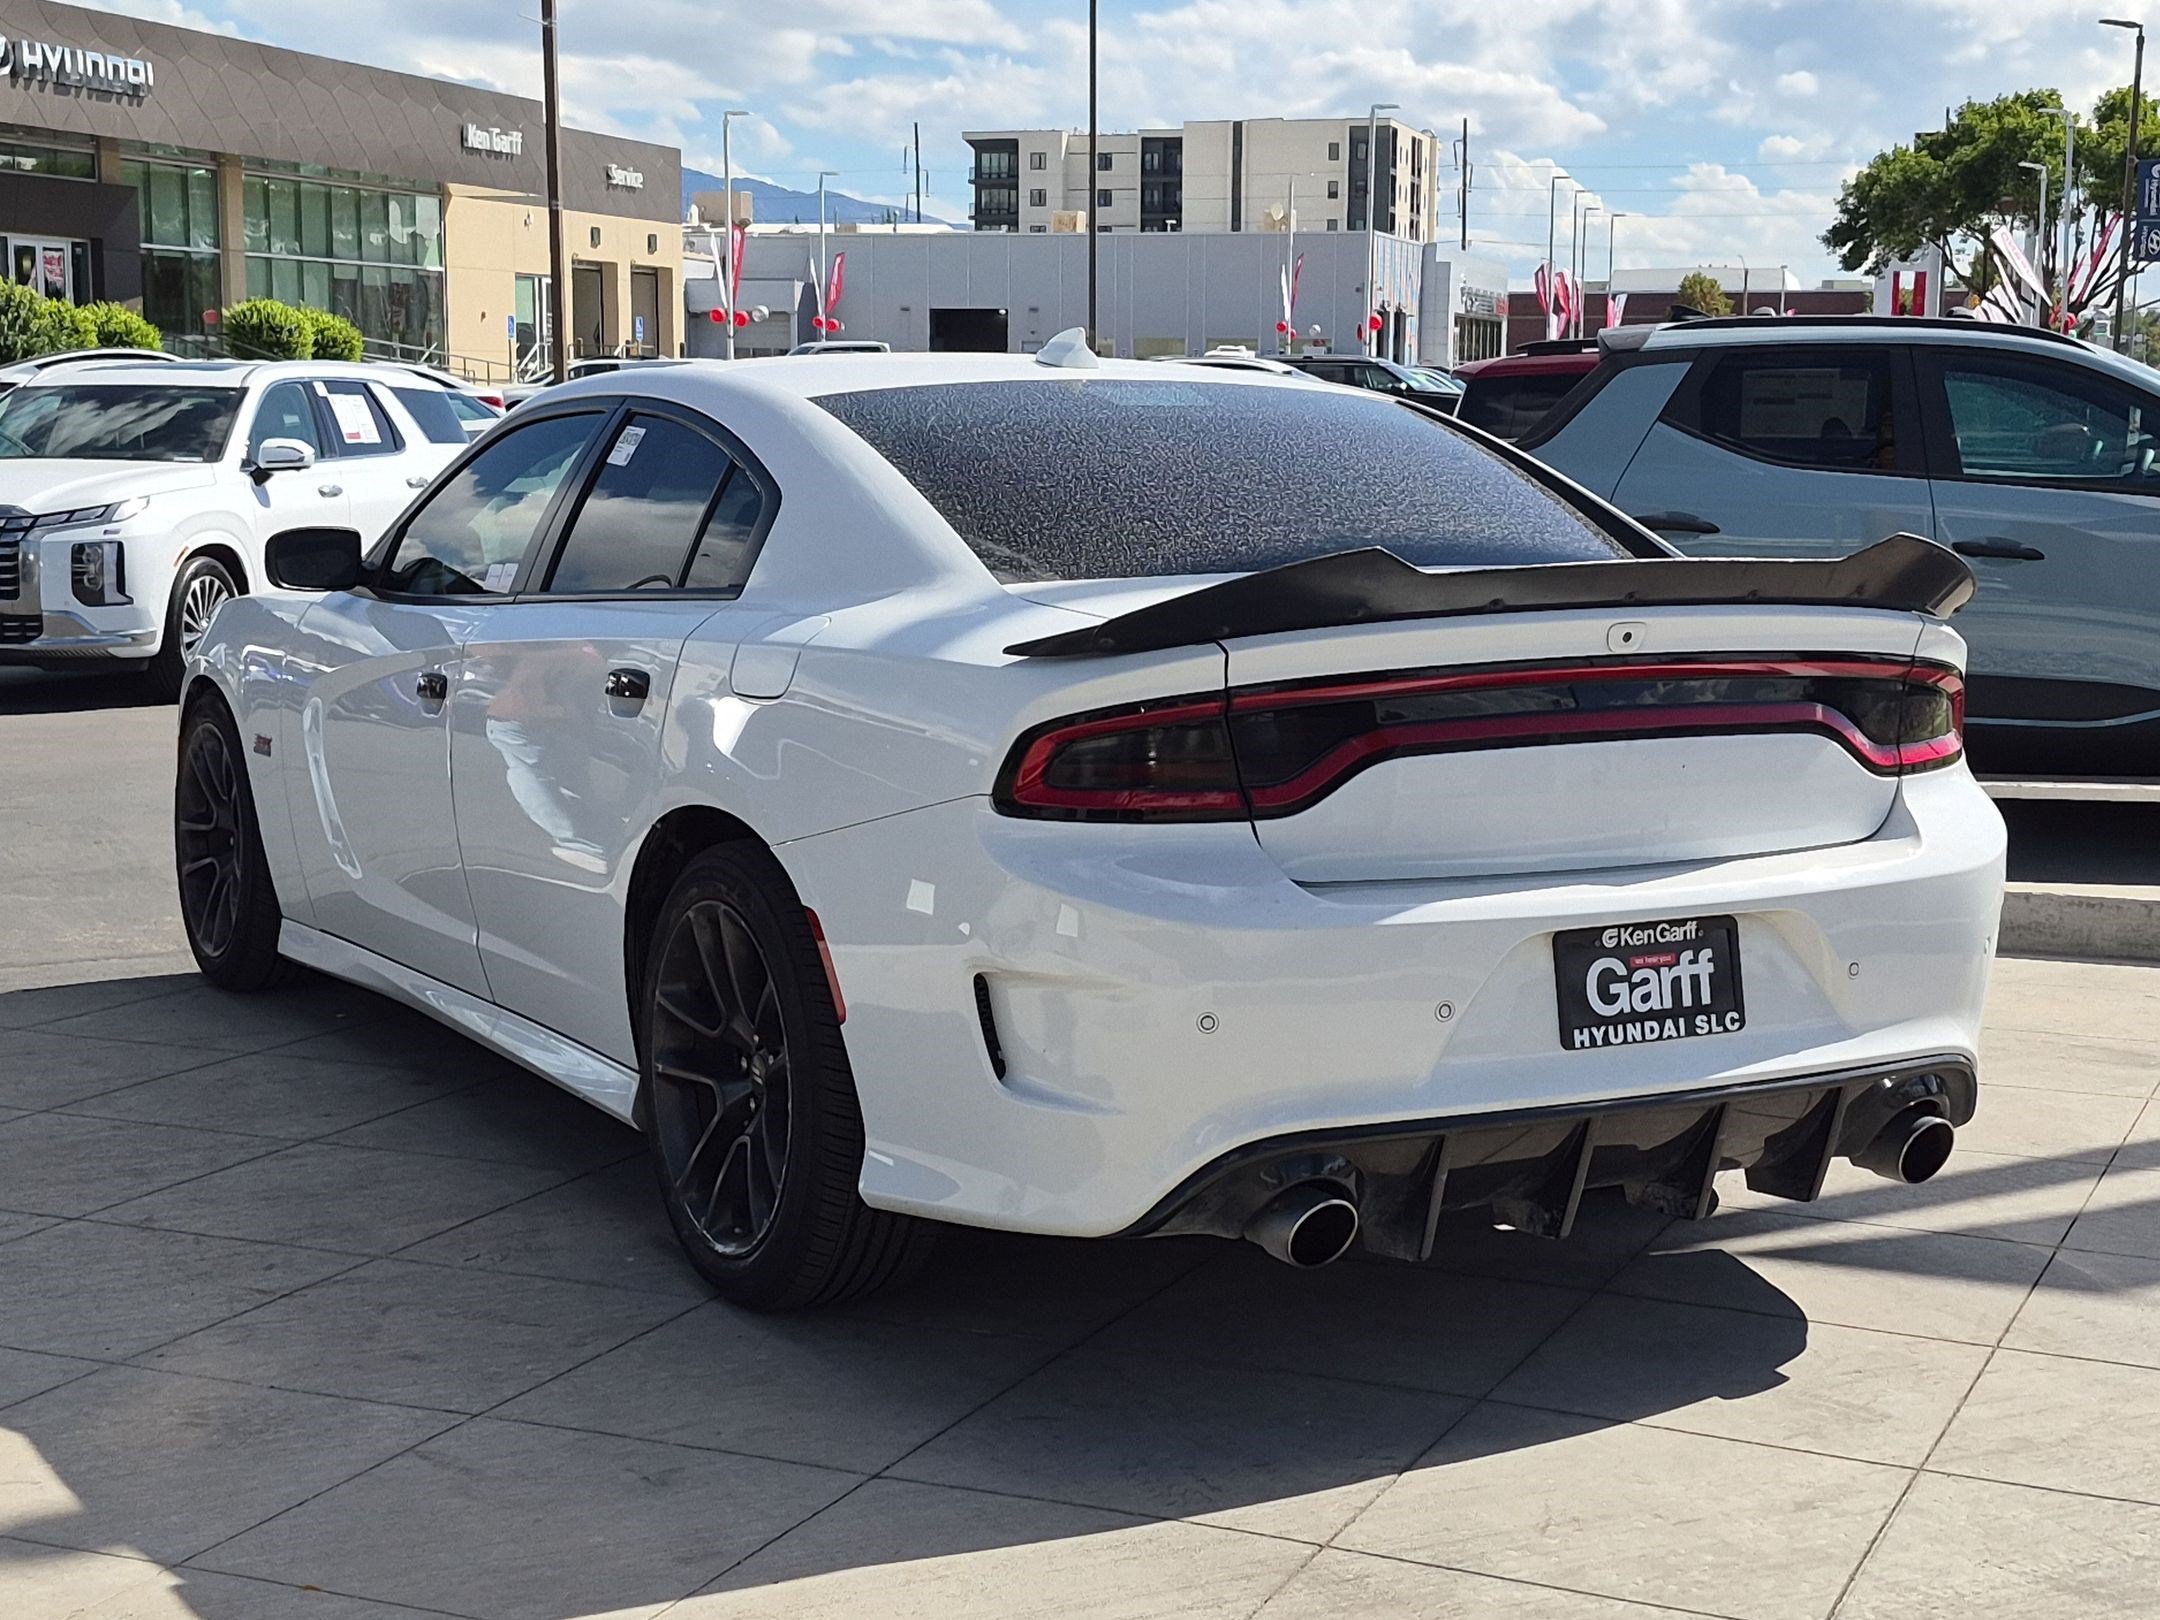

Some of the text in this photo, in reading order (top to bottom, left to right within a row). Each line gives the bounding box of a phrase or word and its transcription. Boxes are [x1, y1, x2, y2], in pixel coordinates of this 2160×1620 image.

[21, 40, 154, 87] HYUNDAI
[467, 123, 523, 156] Ken Garff
[607, 164, 644, 189] Service
[1621, 920, 1697, 947] Ken Garff
[1586, 948, 1715, 1017] Garff
[1573, 1011, 1741, 1049] HYUNDAI SLC
